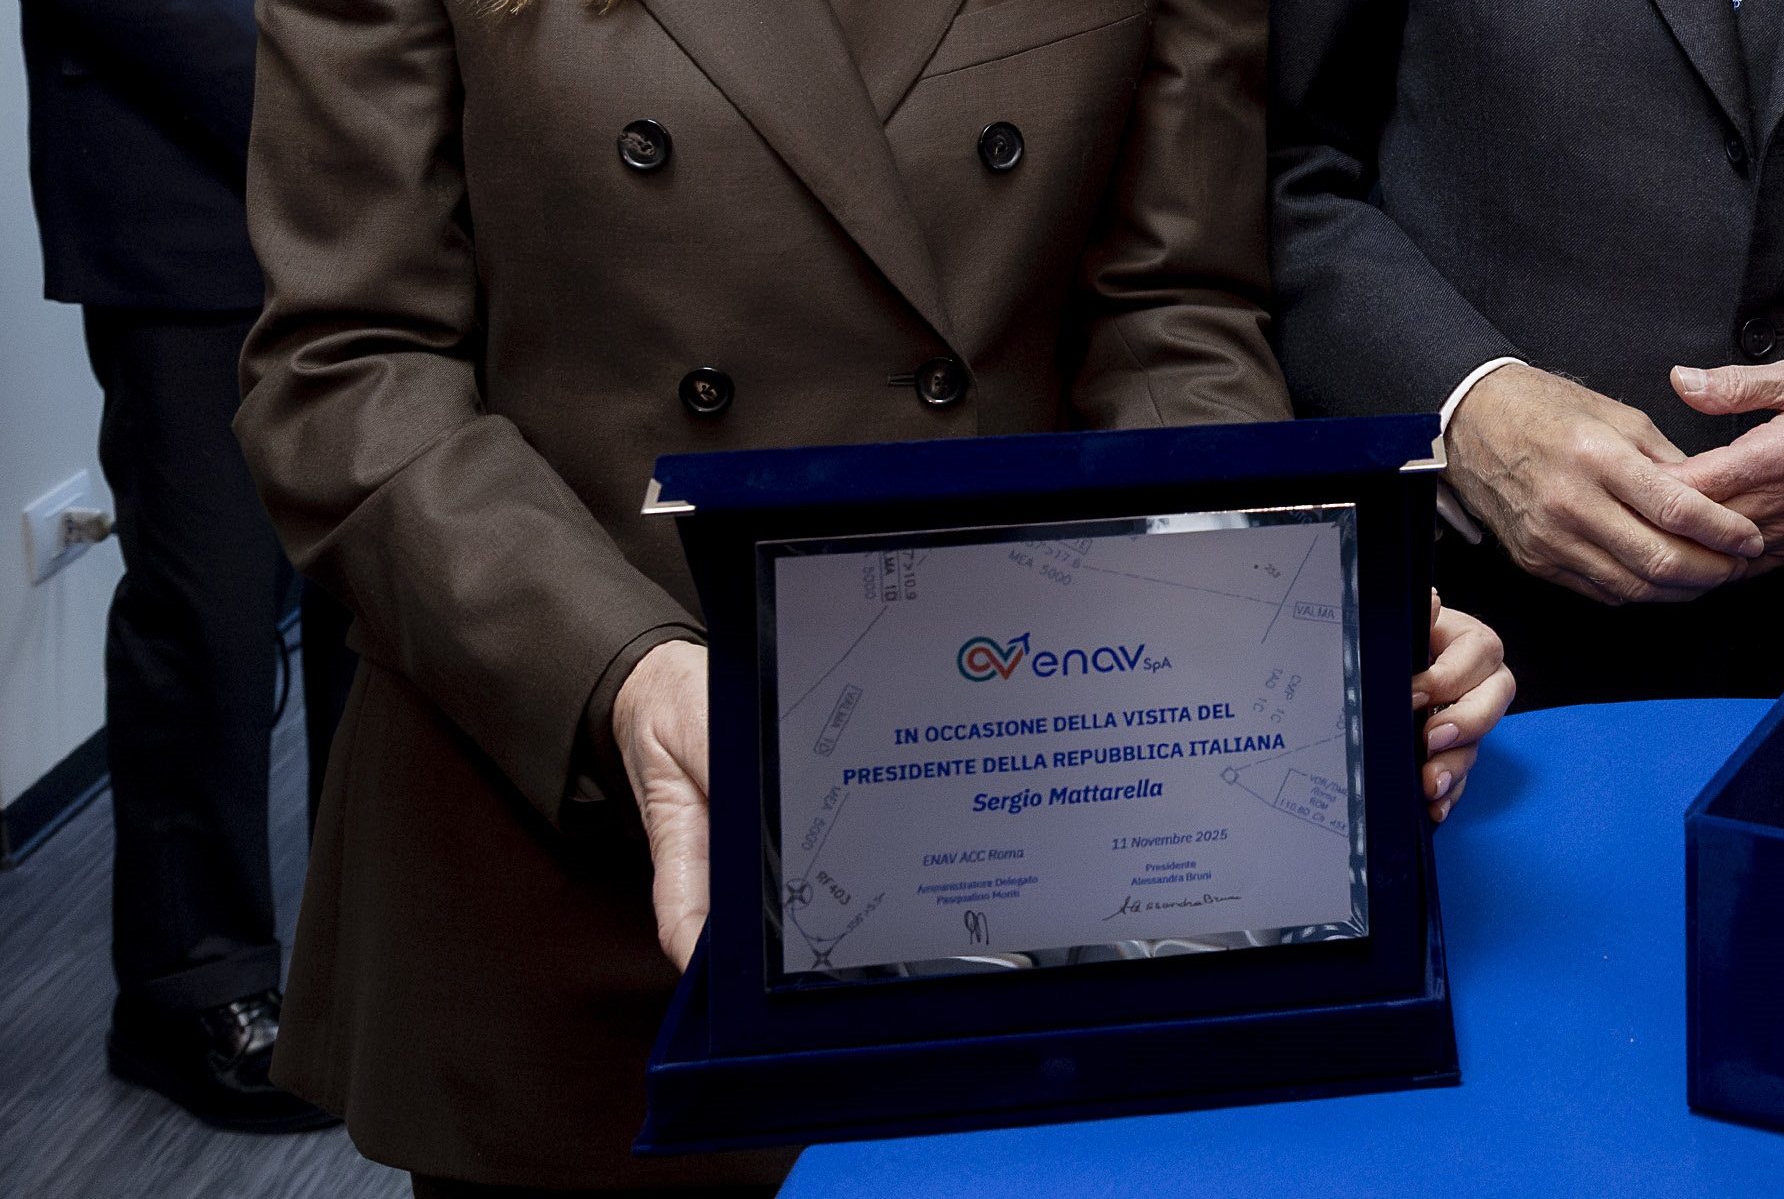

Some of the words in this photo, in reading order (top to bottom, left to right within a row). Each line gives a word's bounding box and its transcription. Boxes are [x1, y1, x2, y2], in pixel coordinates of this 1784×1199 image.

[1297, 605, 1337, 620] VALMA
[1032, 643, 1145, 677] enav
[1143, 657, 1172, 673] SpA
[895, 728, 919, 745] IN
[925, 717, 1048, 743] OCCASIONE
[1053, 711, 1117, 733] DELLA
[1122, 707, 1192, 728] VISITA
[1198, 703, 1235, 721] DEL
[843, 759, 977, 785] PRESIDENTE
[982, 752, 1047, 774] DELLA
[1053, 743, 1184, 768] REPUBBLICA
[1188, 733, 1286, 757] ITALIANA
[972, 787, 1043, 814] Sergio
[1049, 778, 1163, 806] Mattarella
[1112, 837, 1127, 850] 11
[1131, 832, 1193, 850] Novembre
[1195, 828, 1229, 843] 2025
[923, 853, 957, 867] ENAV
[959, 851, 986, 864] ACC
[988, 848, 1025, 861] Roma
[1145, 860, 1197, 872] Presidente
[995, 875, 1039, 889] Delegato
[1131, 872, 1184, 886] Alessandra
[1186, 870, 1212, 882] Bruni
